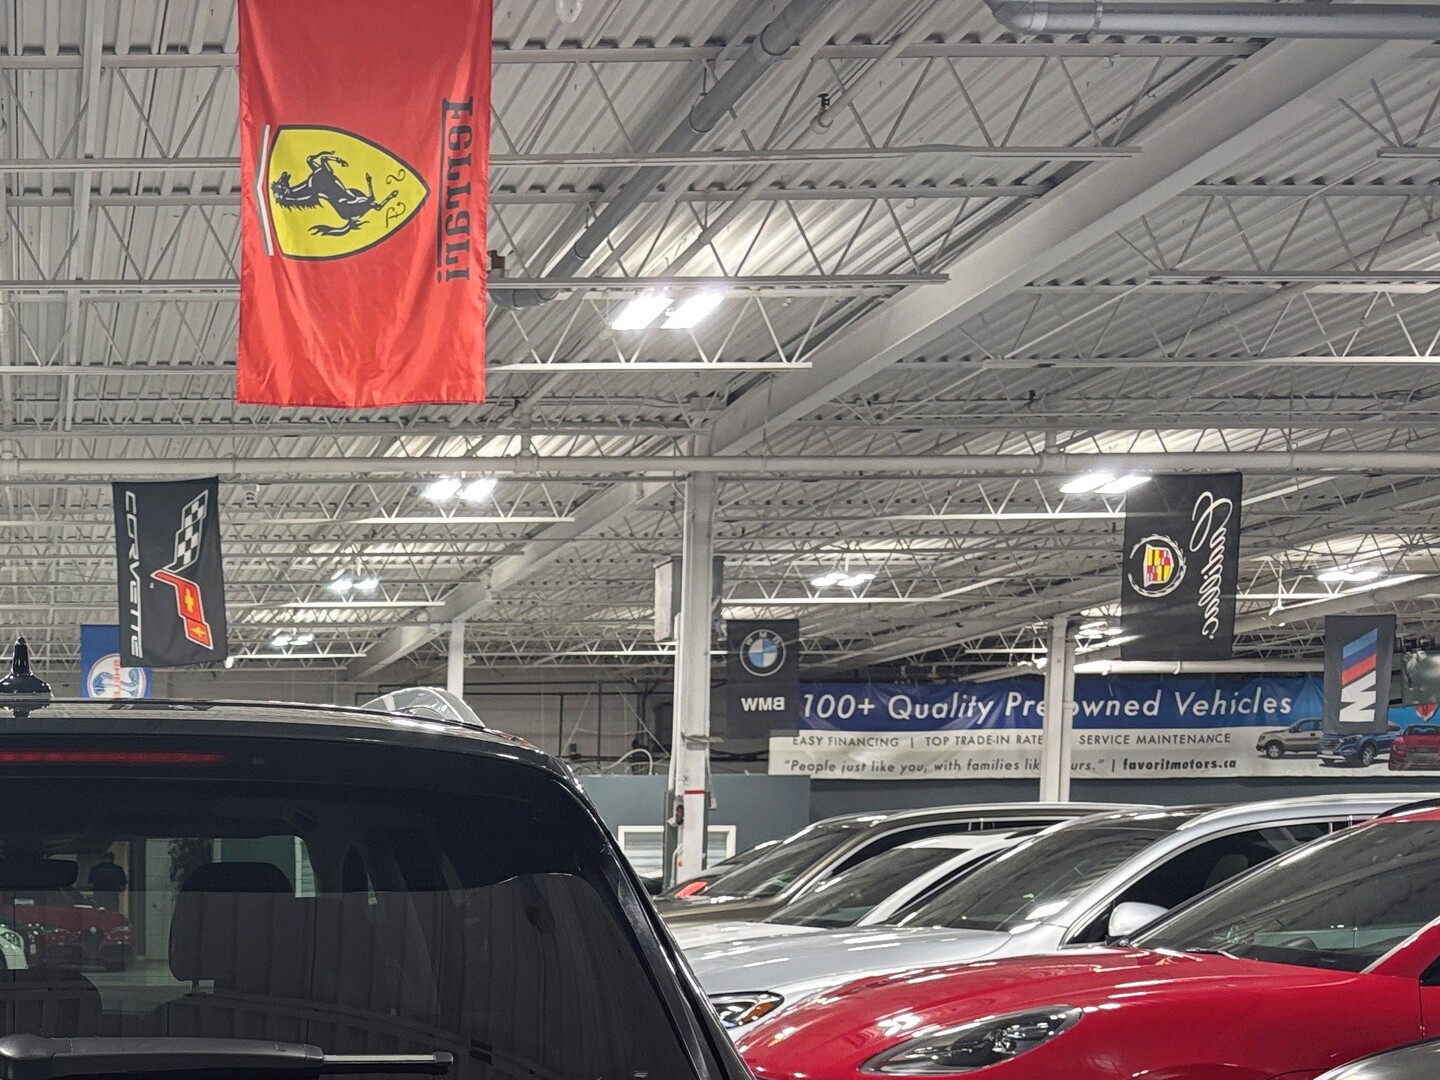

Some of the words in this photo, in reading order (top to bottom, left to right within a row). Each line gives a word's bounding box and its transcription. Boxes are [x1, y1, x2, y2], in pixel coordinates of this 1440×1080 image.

[125, 490, 144, 659] CORVETTE
[803, 693, 876, 719] 100+
[888, 691, 994, 725] Quality
[1174, 687, 1293, 716] Vehicles
[792, 736, 823, 747] EASY
[828, 736, 899, 748] FINANCING
[926, 736, 950, 747] TOP
[955, 735, 1010, 747] TRADE-IN
[1016, 735, 1044, 746] RATE
[1079, 734, 1130, 746] SERVICE
[1136, 733, 1231, 745] MAINTENANCE
[840, 762, 866, 776] just
[871, 760, 896, 773] like
[934, 760, 961, 772] with
[967, 758, 1020, 772] families
[1024, 758, 1040, 770] lik
[1122, 757, 1237, 771] favoritmotors.ca
